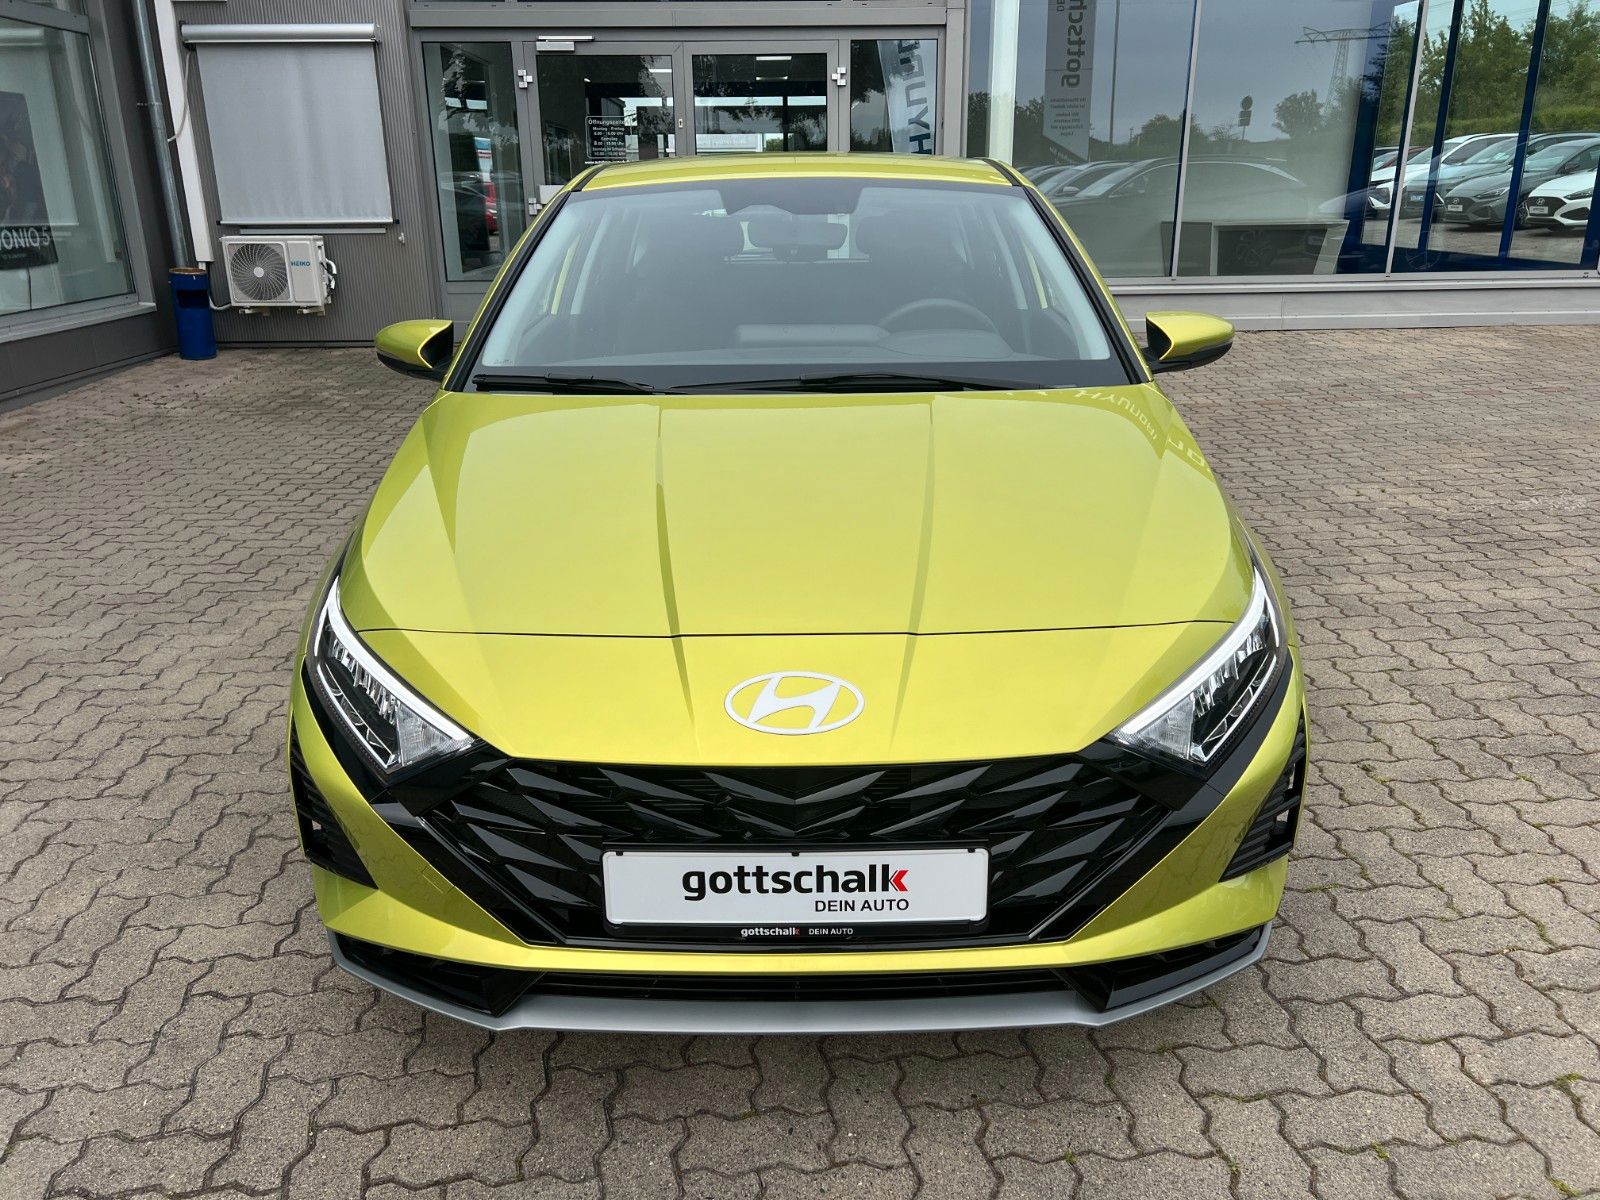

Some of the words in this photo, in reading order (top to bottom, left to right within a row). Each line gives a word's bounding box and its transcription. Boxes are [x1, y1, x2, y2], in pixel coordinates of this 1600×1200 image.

[588, 118, 628, 126] Öffnungszeite
[682, 864, 909, 901] gottschalk
[814, 900, 856, 912] DEIN
[860, 899, 910, 912] AUTO
[740, 927, 800, 937] gottschalk
[808, 928, 829, 936] DEIN
[830, 928, 854, 936] AUTO
